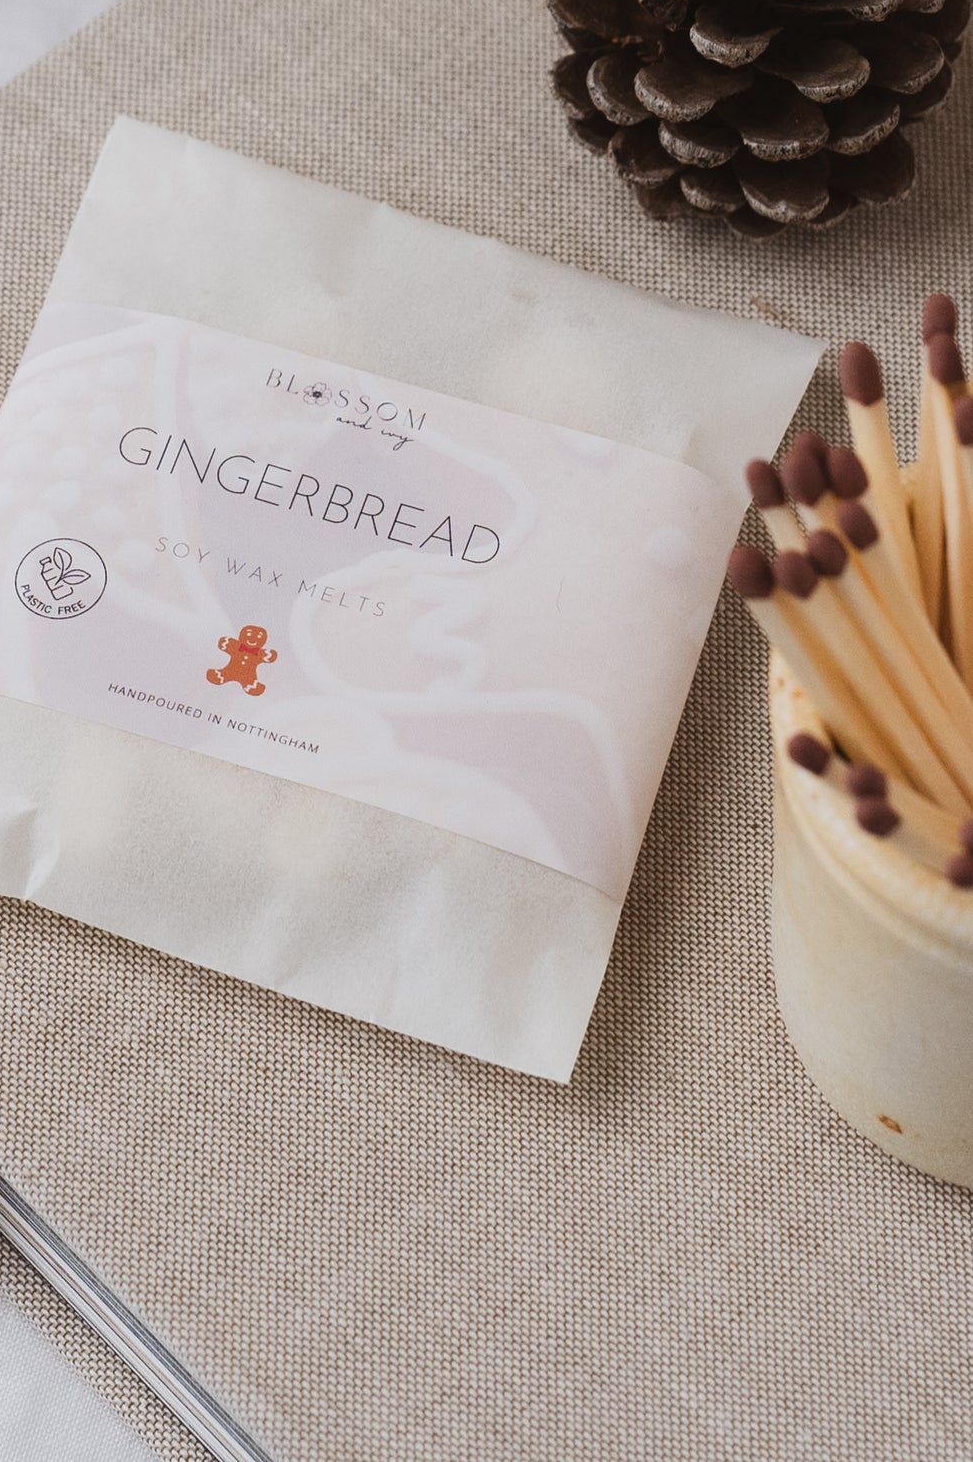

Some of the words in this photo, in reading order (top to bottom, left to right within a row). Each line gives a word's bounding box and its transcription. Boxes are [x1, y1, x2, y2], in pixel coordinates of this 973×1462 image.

[335, 414, 371, 431] and
[380, 428, 415, 451] ivy
[118, 426, 501, 565] GINGERBREAD
[20, 583, 53, 615] PLASTIC
[57, 599, 87, 616] FREE
[155, 536, 211, 564] SOY
[225, 556, 282, 588] WAX
[298, 579, 388, 617] MELTS
[107, 682, 204, 719] HANDPOURED
[207, 711, 222, 726] IN
[226, 717, 320, 755] NOTTINGHAM
